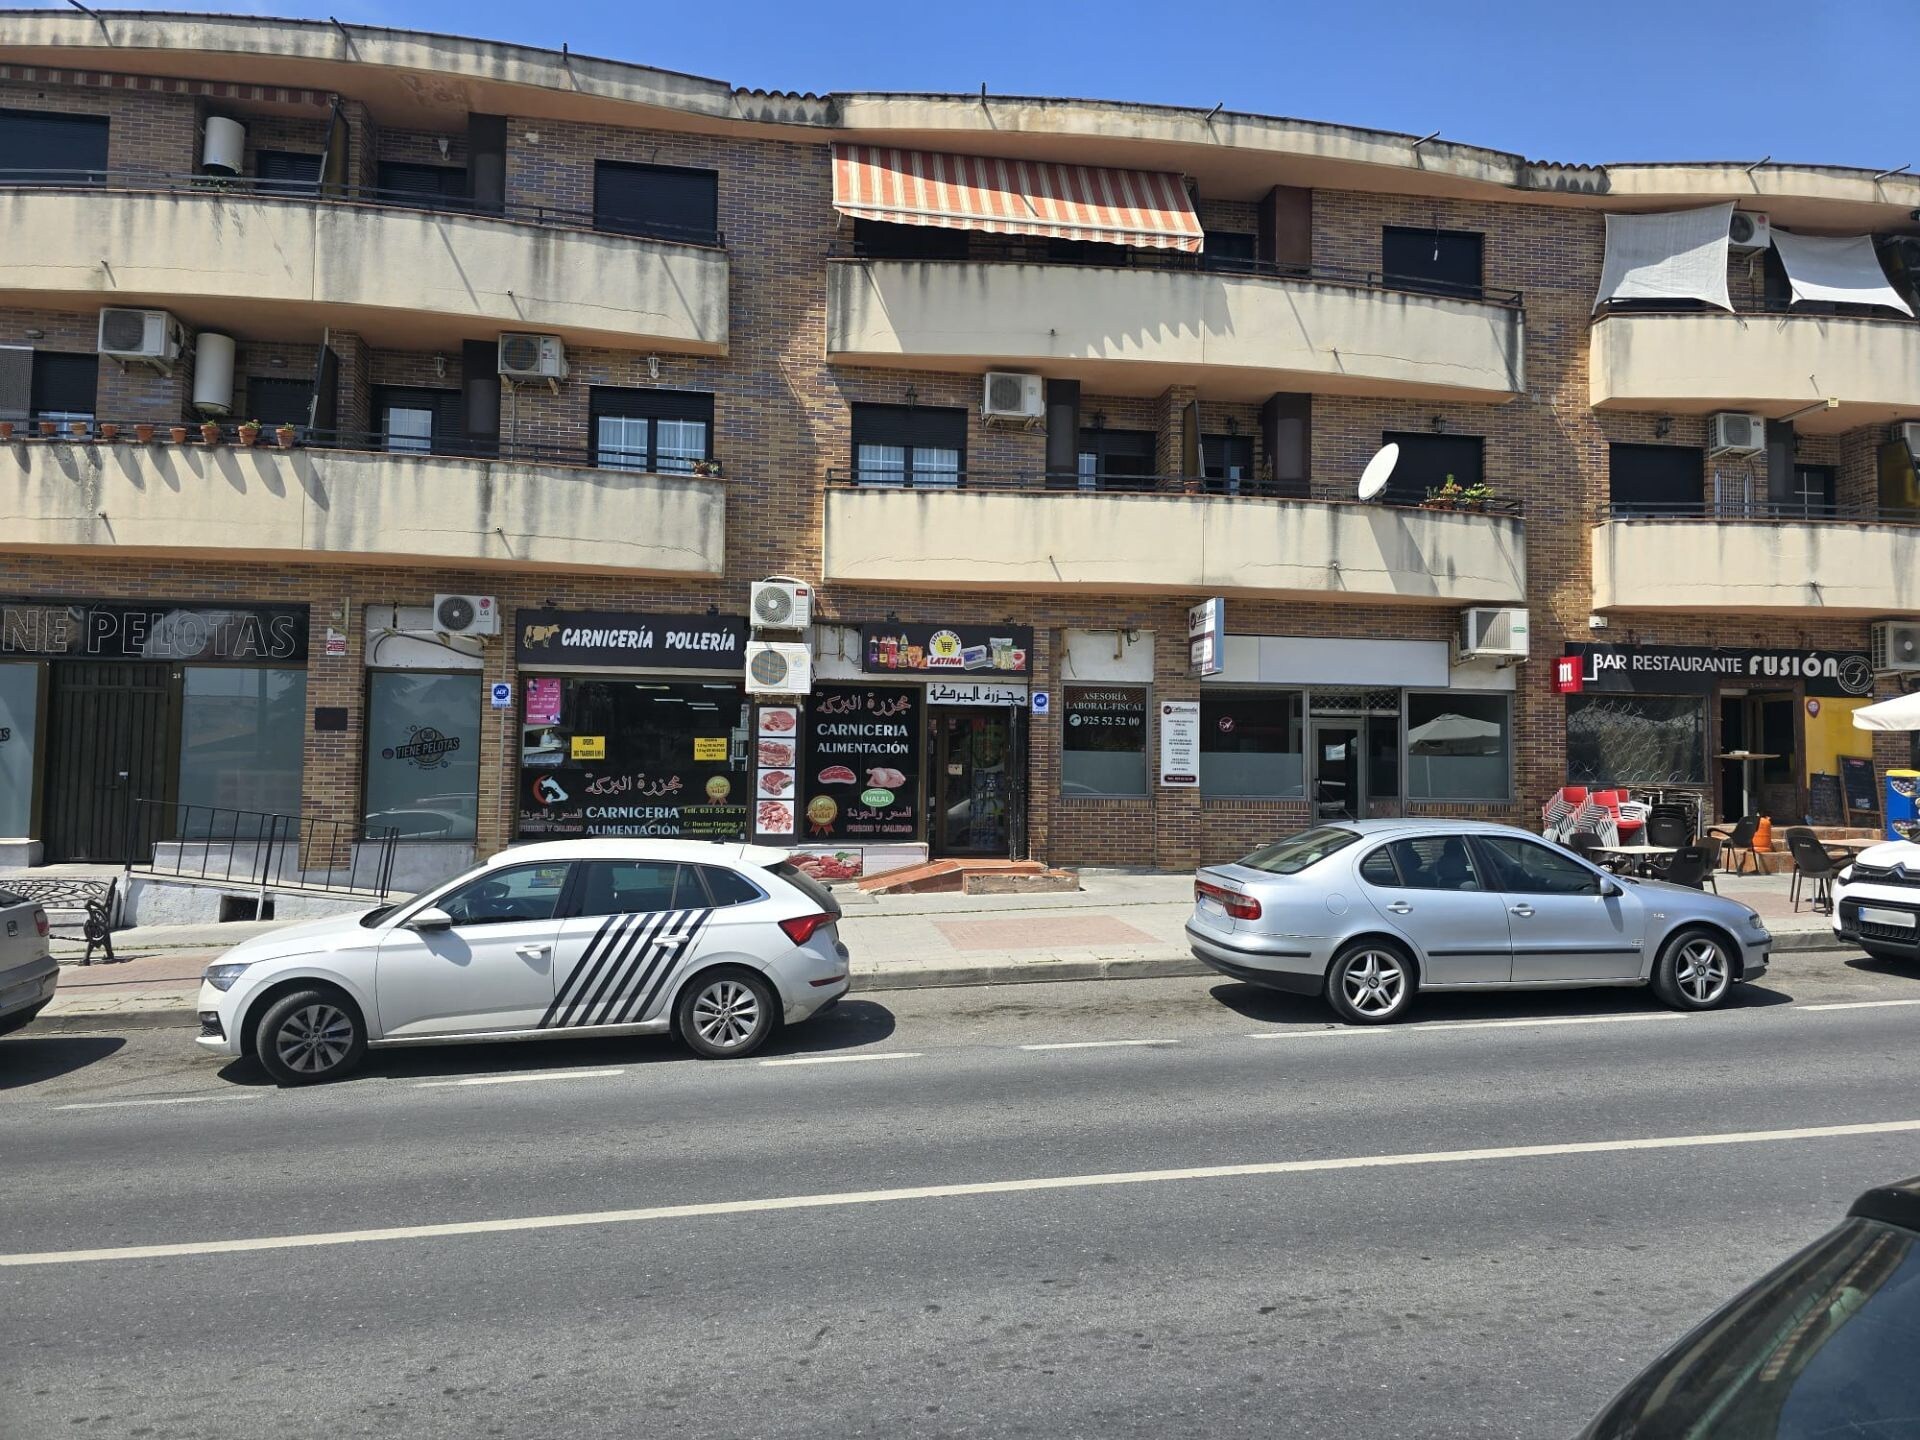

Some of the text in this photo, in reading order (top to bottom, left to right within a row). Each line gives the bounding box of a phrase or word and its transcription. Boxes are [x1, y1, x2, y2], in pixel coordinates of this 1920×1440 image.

[3, 609, 296, 659] NE PELOTAS
[561, 625, 736, 651] CARNICERÍA POLLERÍA
[929, 656, 962, 666] LATINA
[1593, 653, 1627, 670] BAR
[1632, 655, 1742, 673] RESTAURANTE
[1066, 701, 1144, 711] LABORAL-FISCAL
[1083, 716, 1140, 726] 925 52 52 00
[816, 723, 909, 736] CARNICERIA
[422, 737, 460, 755] PELOTAS
[816, 741, 910, 754] ALIMENTACIÓN
[865, 795, 889, 803] HALAL
[586, 806, 680, 819] CARNICERIA
[585, 823, 680, 835] ALIMENTACIÓN
[874, 824, 881, 833] Y
